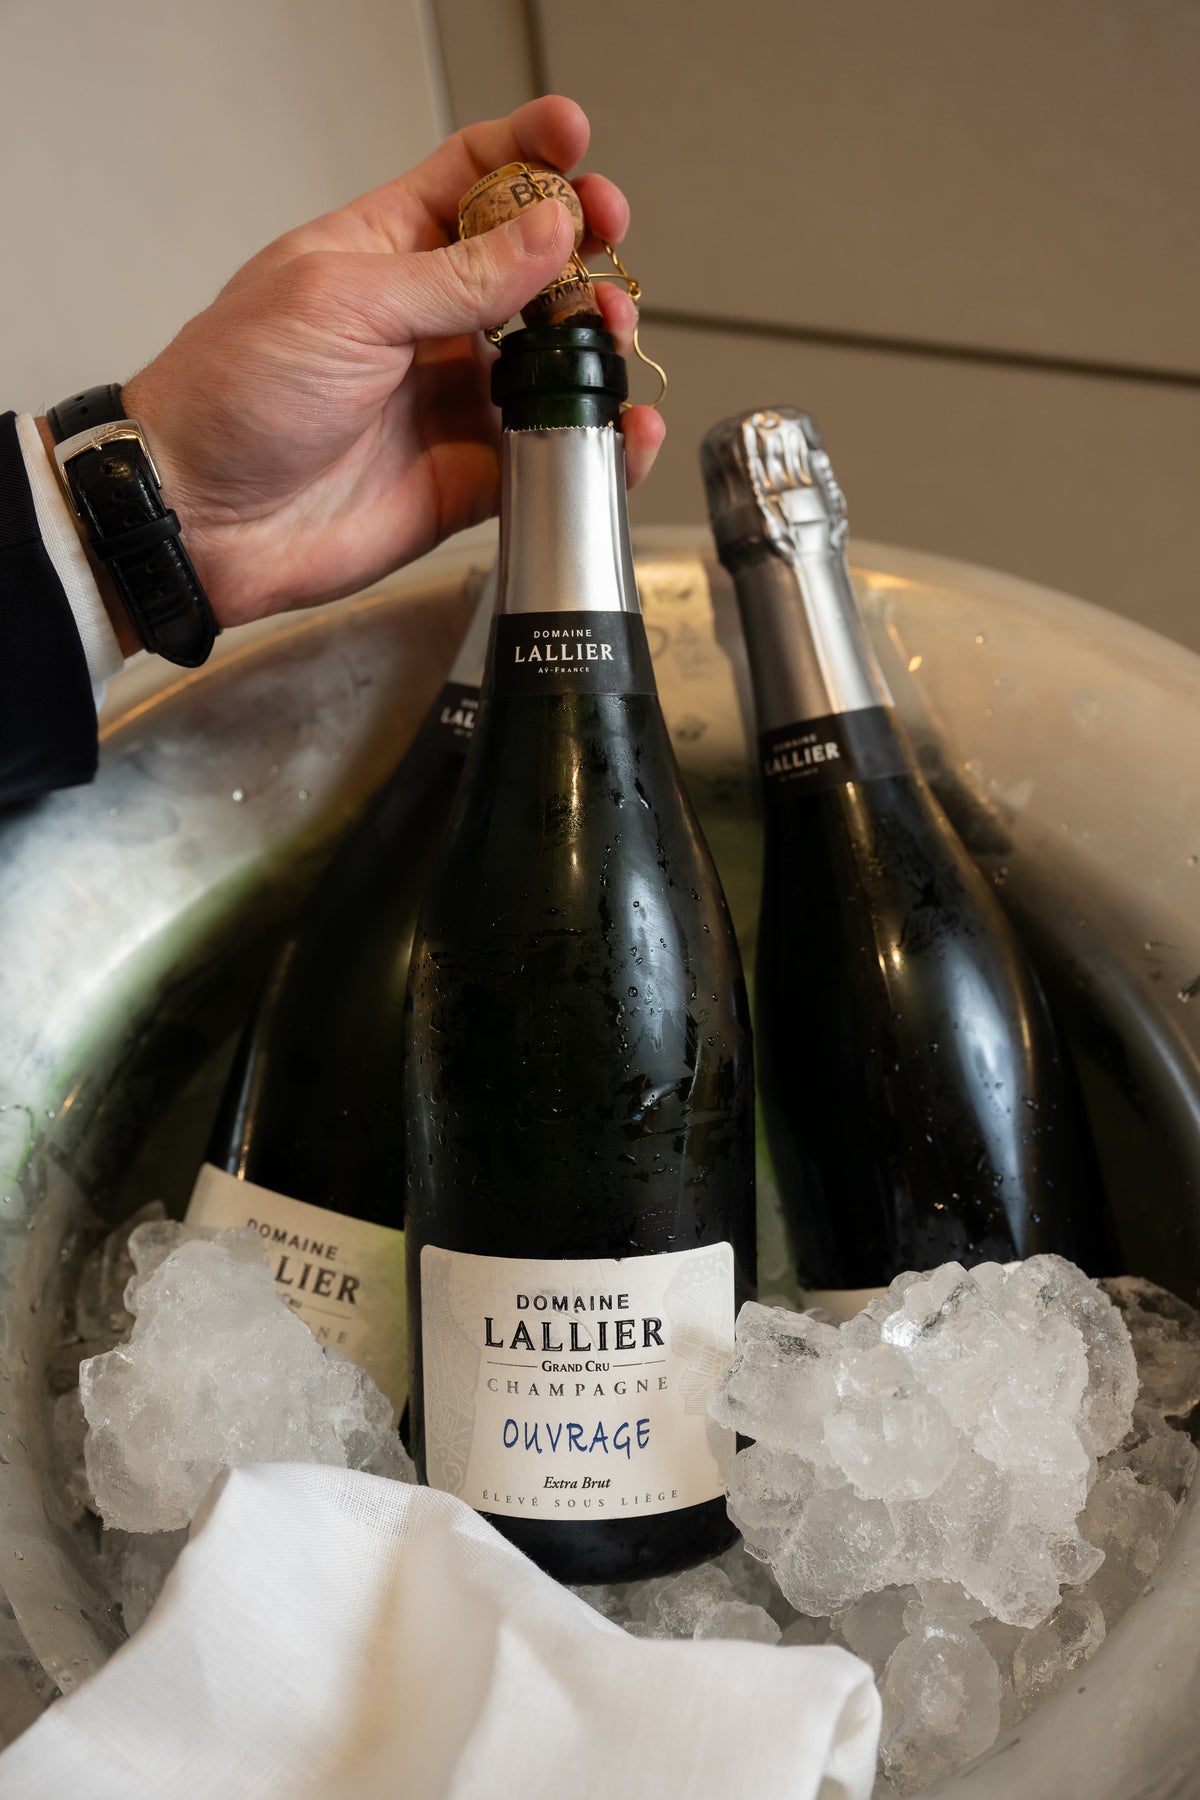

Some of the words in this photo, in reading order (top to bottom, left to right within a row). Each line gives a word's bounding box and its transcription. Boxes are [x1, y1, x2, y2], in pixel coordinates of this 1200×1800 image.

[533, 629, 592, 639] DOMAINE
[514, 643, 615, 663] LALLIER
[274, 1255, 361, 1305] LIER
[516, 1293, 630, 1312] DOMAINE
[483, 1316, 665, 1352] LALLIER
[541, 1360, 583, 1373] GRAND
[585, 1360, 610, 1372] CRU
[486, 1376, 669, 1397] CHAMPAGNE
[502, 1418, 651, 1460] OUVRAGE
[543, 1476, 578, 1489] Extra
[581, 1476, 611, 1489] Brut
[482, 1489, 539, 1507] ÉLEVÉ
[554, 1498, 605, 1508] SOUS
[621, 1489, 678, 1506] LIÈGE
